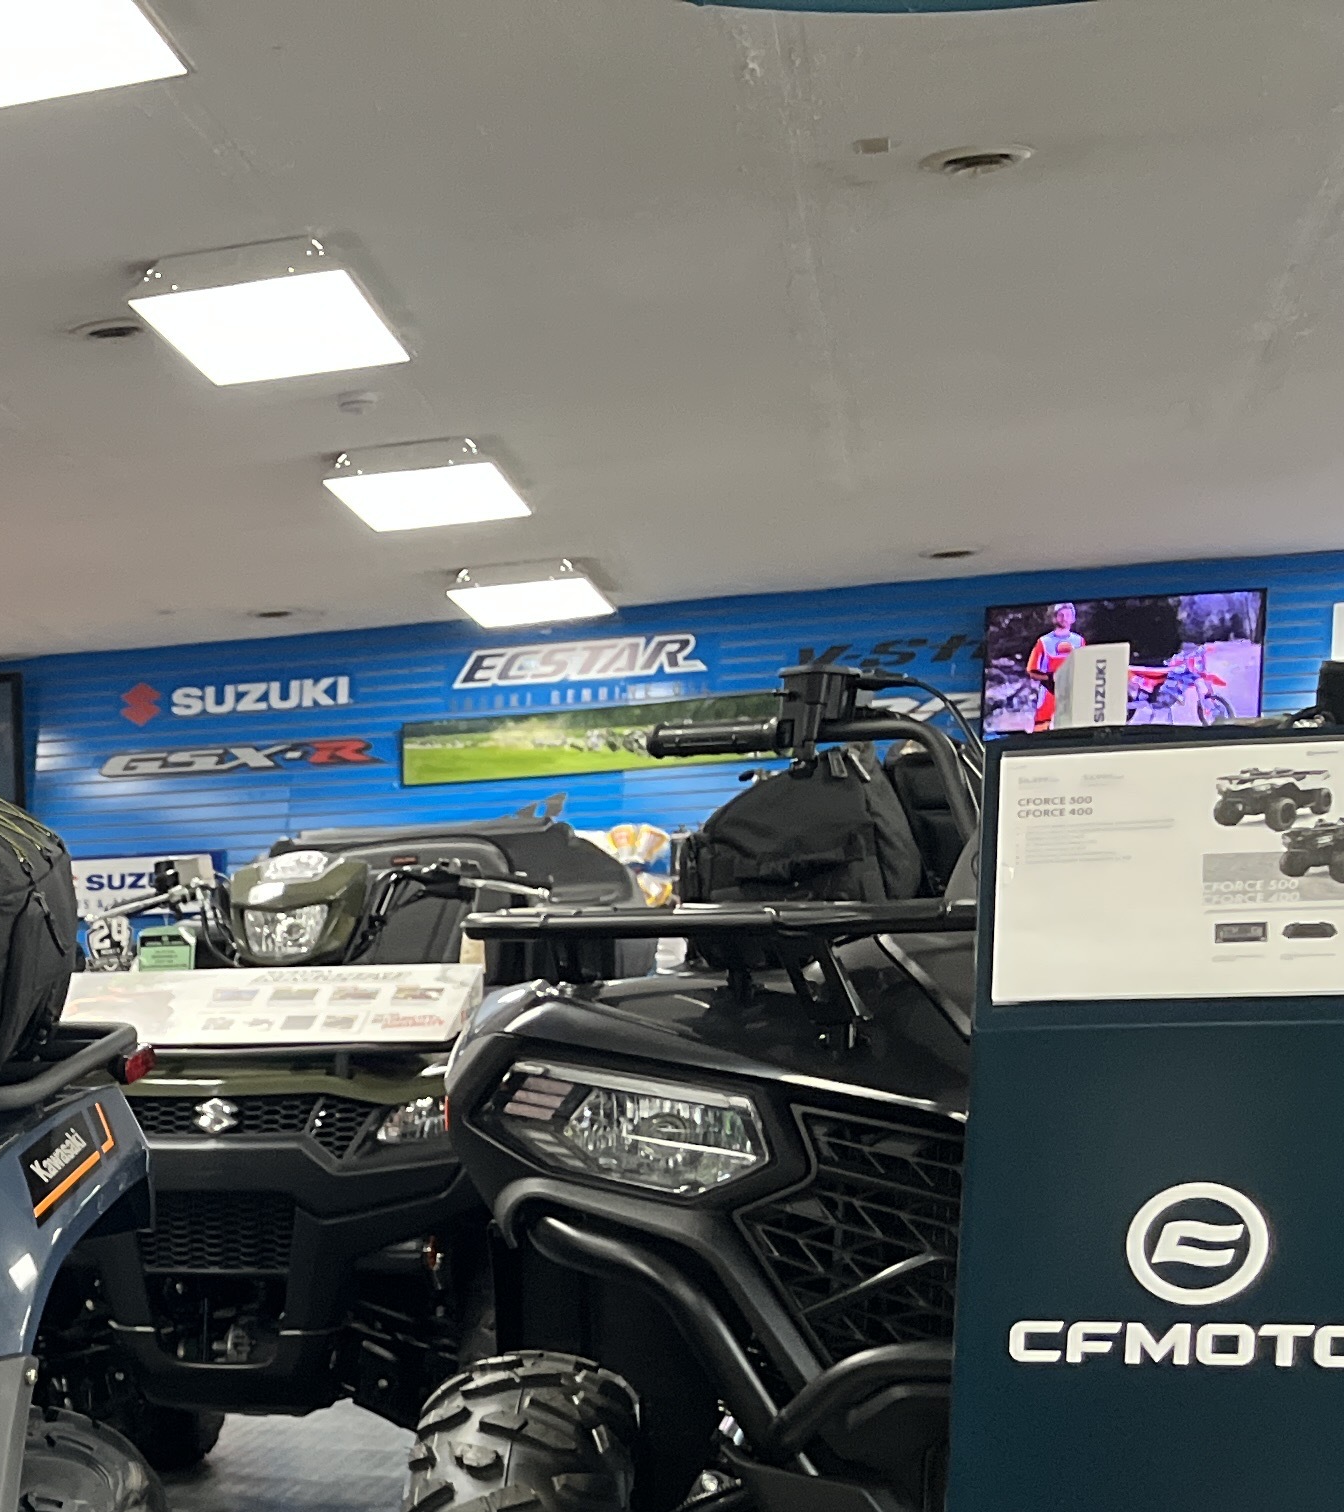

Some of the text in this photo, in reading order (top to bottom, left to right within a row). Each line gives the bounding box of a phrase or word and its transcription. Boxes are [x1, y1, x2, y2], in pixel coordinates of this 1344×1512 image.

[452, 633, 708, 690] ECSTAR
[171, 675, 351, 717] SUZUKI
[1093, 659, 1107, 723] SUZUKI
[100, 738, 378, 778] GSX-R
[1017, 796, 1066, 807] CFORCE
[1017, 807, 1093, 819] CFORCE 400
[85, 871, 157, 891] SUZ
[1203, 880, 1264, 893] CFORCE
[29, 1127, 88, 1184] Kawasaki
